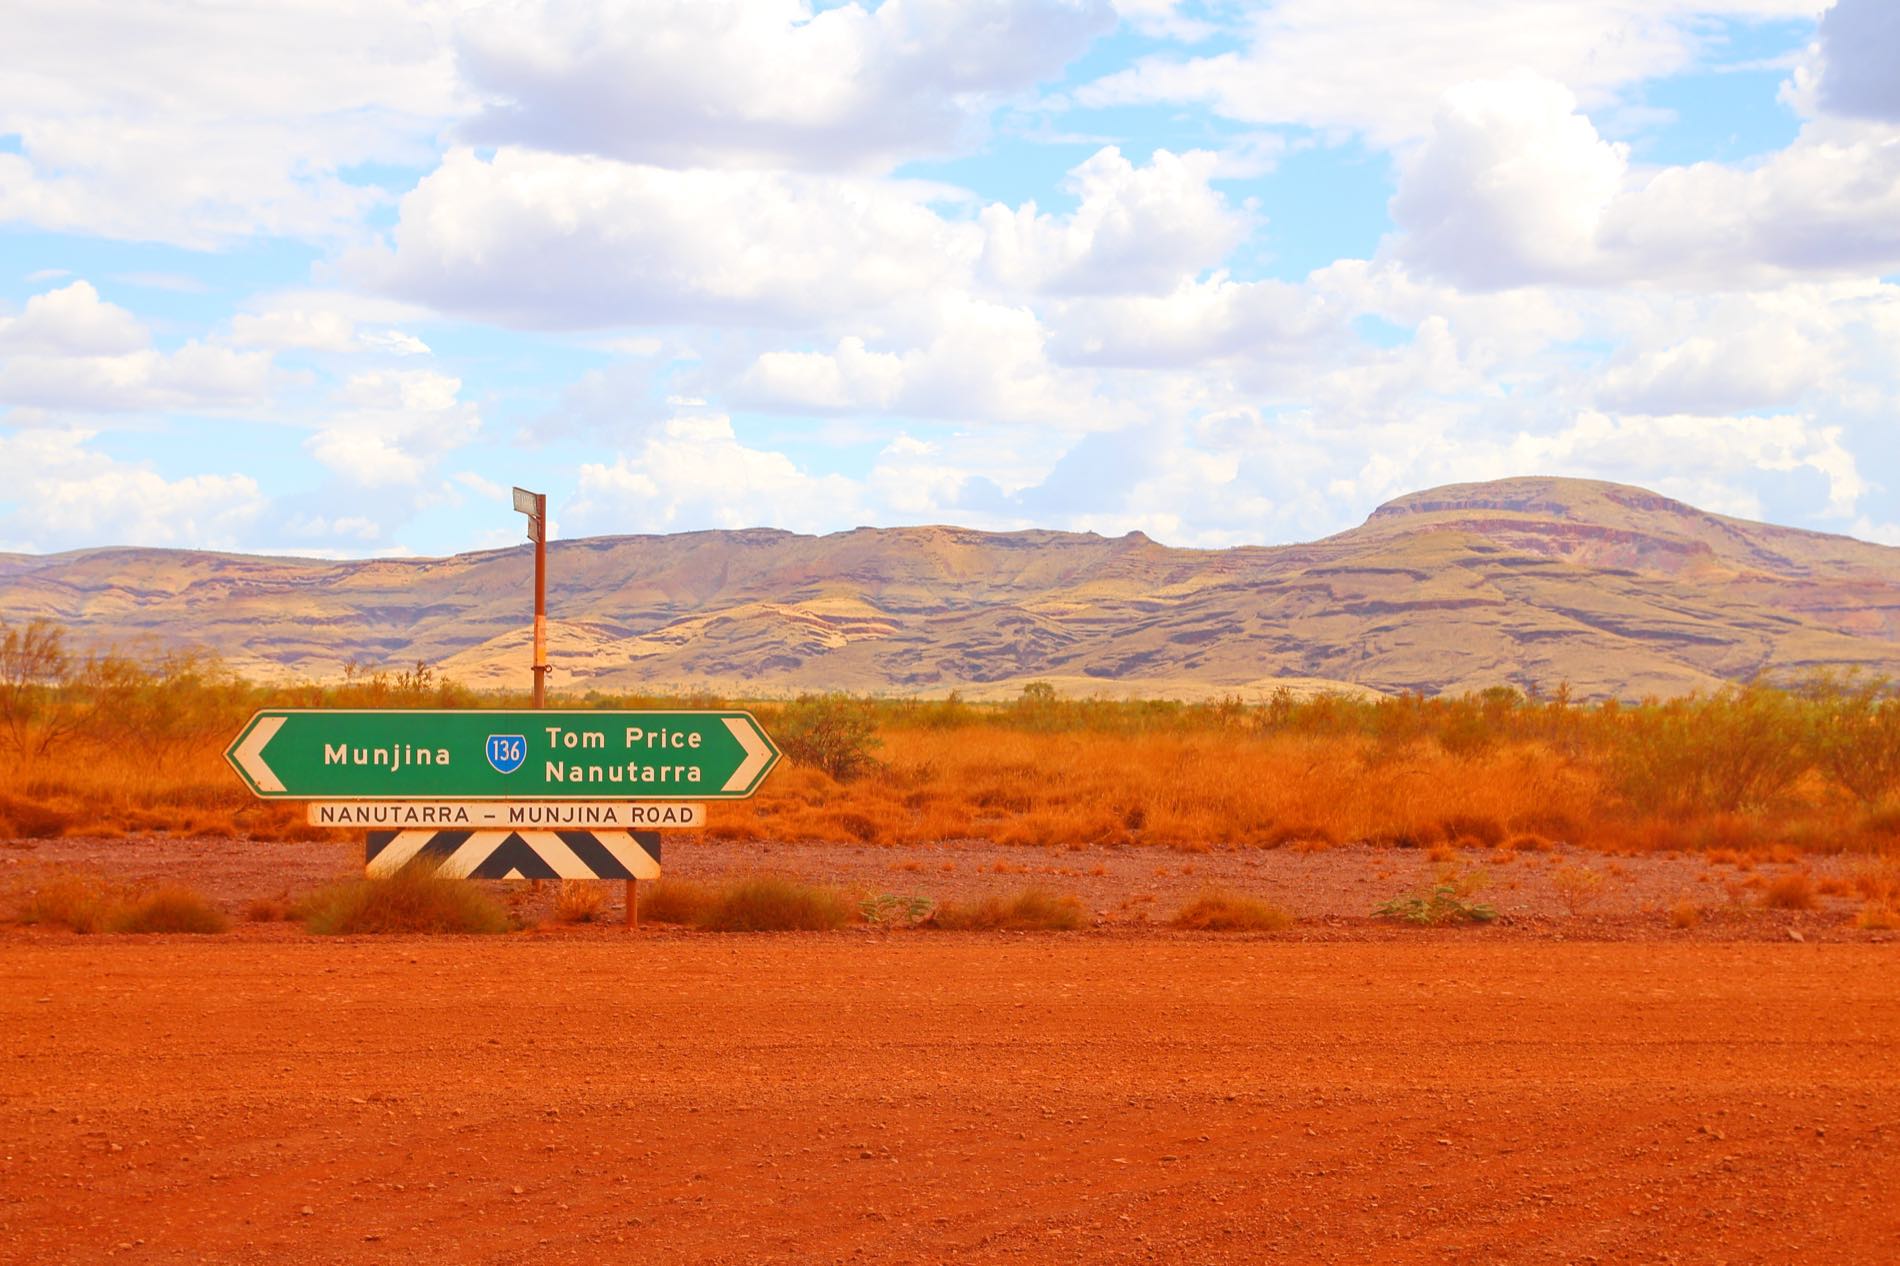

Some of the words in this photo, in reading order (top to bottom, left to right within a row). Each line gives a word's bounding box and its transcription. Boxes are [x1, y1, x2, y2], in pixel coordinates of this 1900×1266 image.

[545, 727, 605, 749] Tom
[626, 727, 702, 749] Price
[324, 743, 450, 772] Munjina
[492, 739, 521, 762] 136
[545, 761, 701, 783] Nanutarra
[320, 806, 470, 824] NANUTARRA
[509, 807, 618, 823] MUNJINA
[632, 806, 693, 823] ROAD
